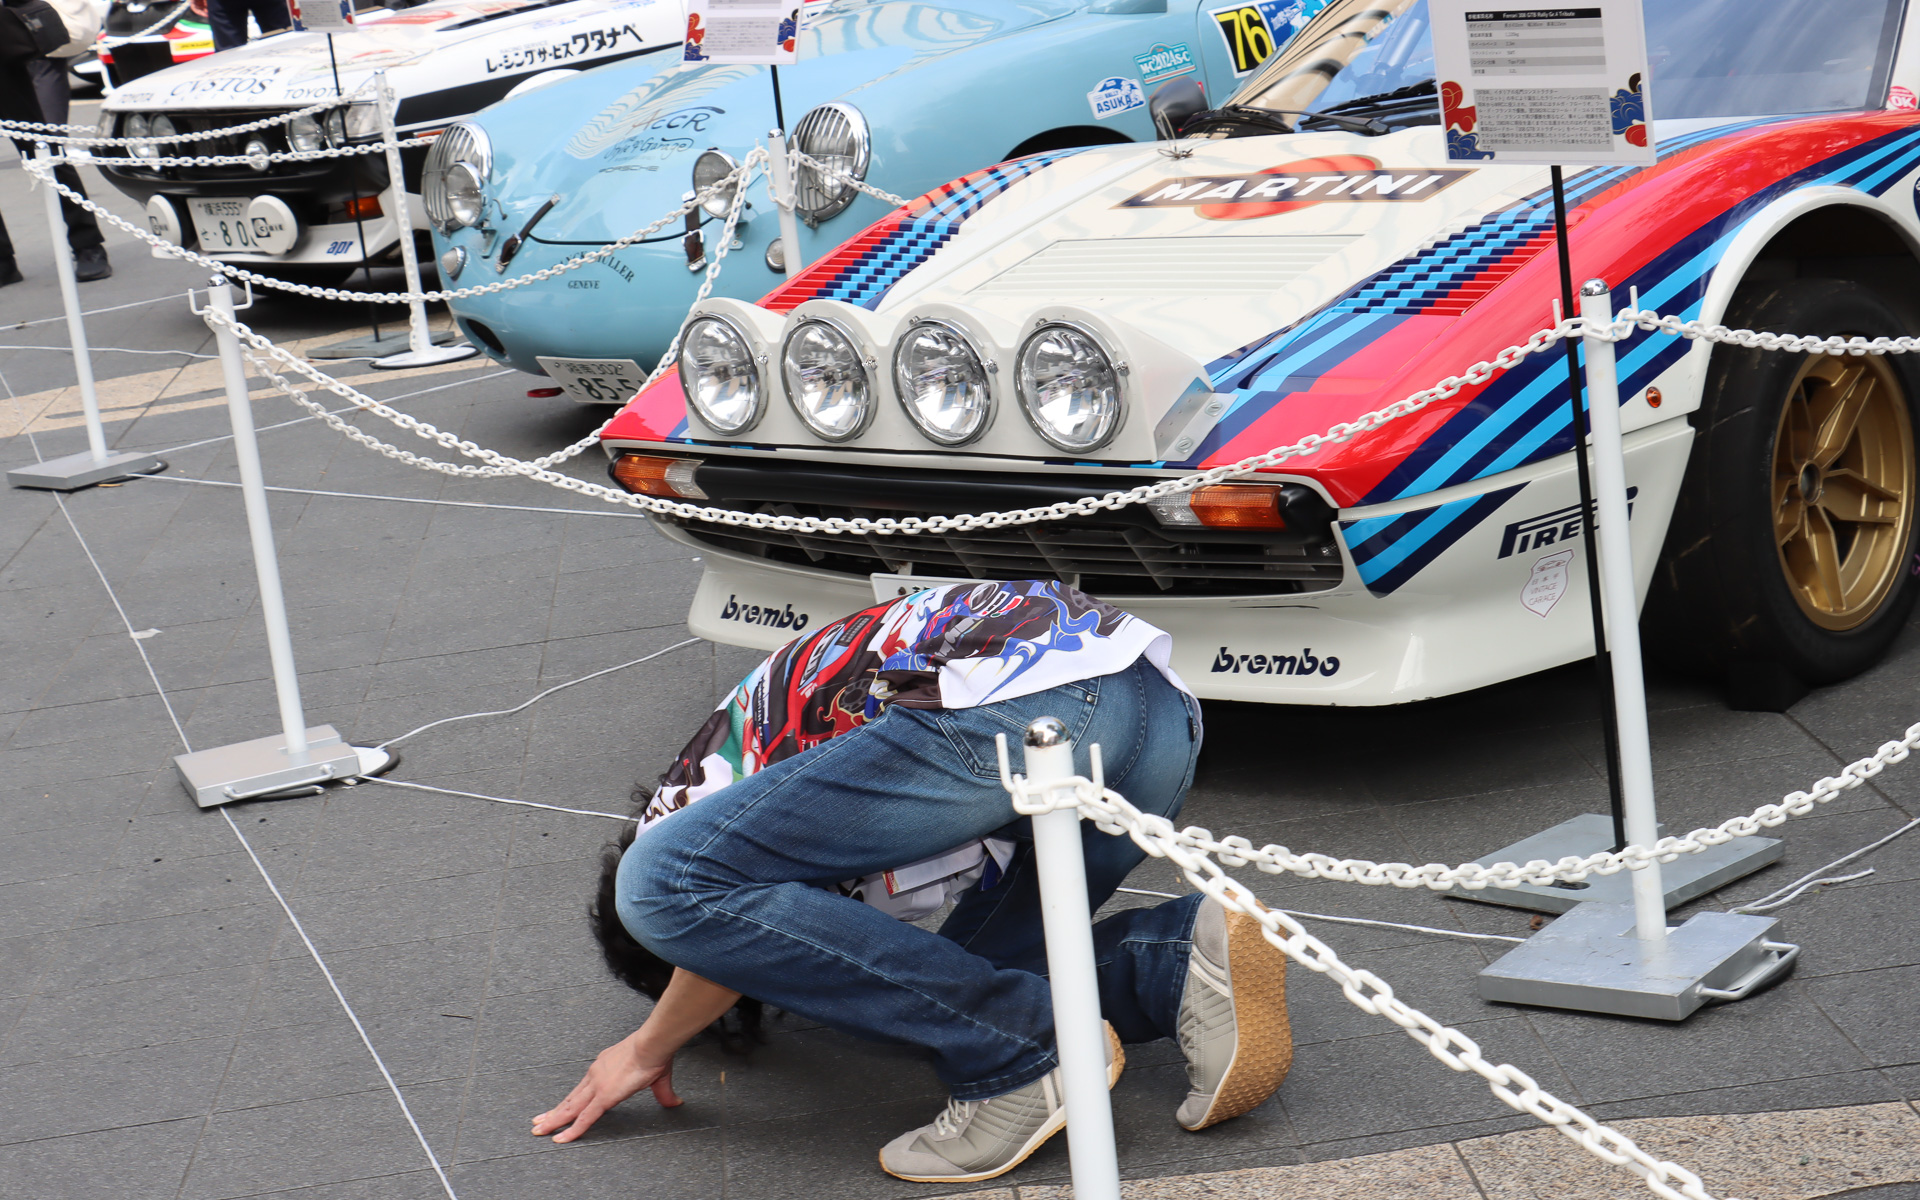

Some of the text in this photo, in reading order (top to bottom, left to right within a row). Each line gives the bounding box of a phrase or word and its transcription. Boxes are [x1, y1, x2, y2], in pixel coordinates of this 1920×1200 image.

[1215, 8, 1273, 70] 76
[283, 87, 345, 99] TOYOTA
[1891, 95, 1915, 109] OK
[1096, 95, 1131, 114] ASUKA
[1141, 174, 1444, 202] MARTINI
[326, 239, 354, 256] apr
[567, 280, 600, 289] GENEVE
[577, 377, 645, 400] 85-5
[721, 594, 809, 631] brembo
[1211, 646, 1341, 677] brembo
